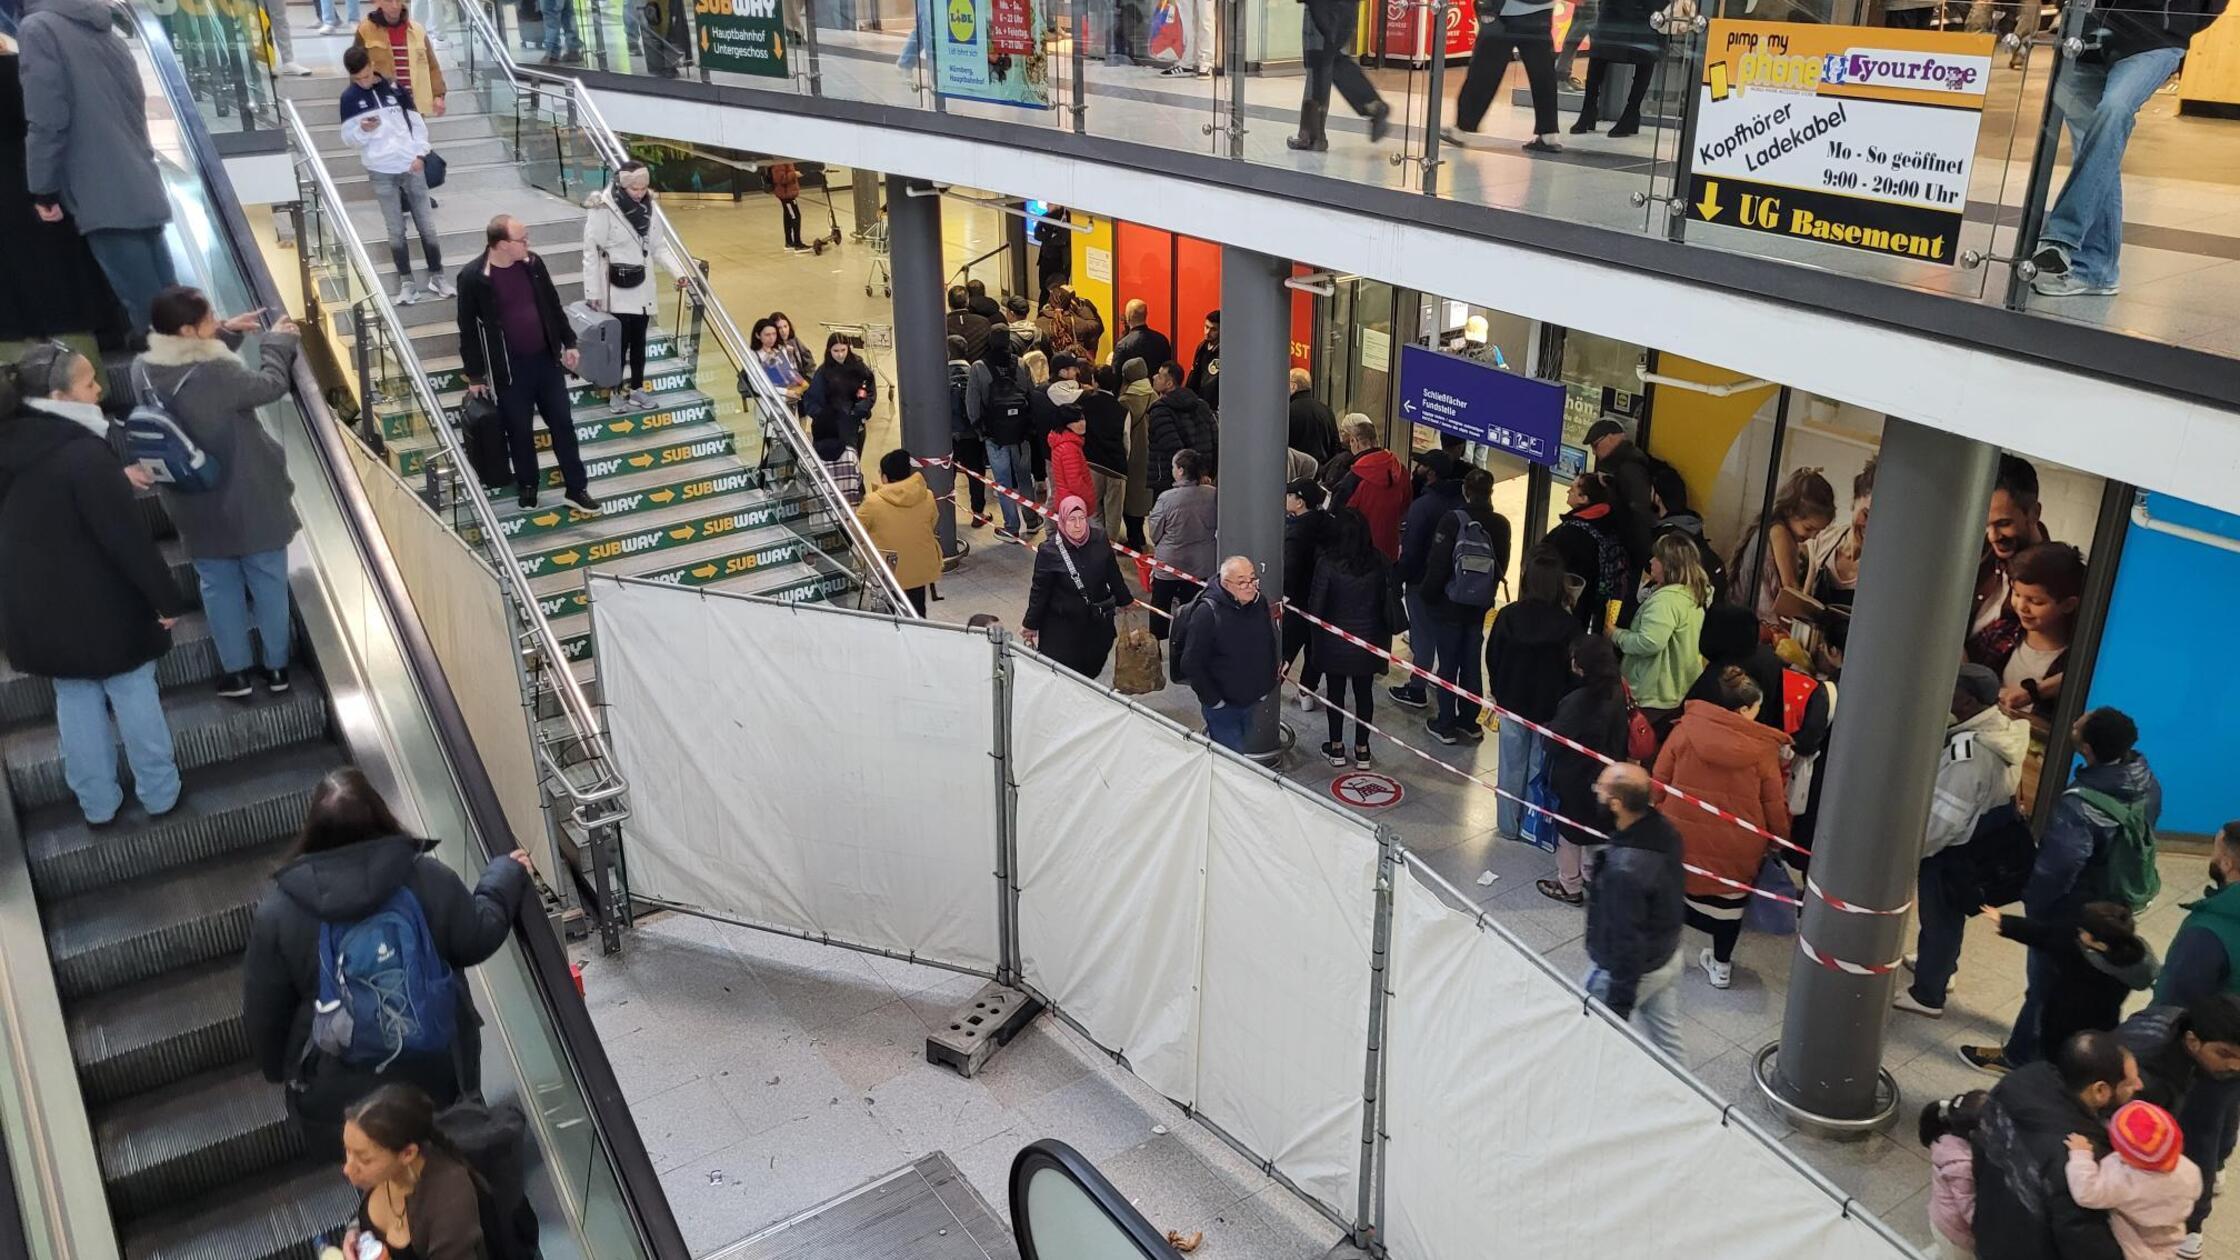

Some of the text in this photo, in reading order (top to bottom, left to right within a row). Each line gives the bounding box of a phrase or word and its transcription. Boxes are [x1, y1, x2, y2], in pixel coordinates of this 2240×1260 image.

[696, 0, 776, 18] SUBWAY
[711, 26, 766, 42] Hauptbahnhof
[1726, 31, 1789, 54] pimp my
[713, 42, 769, 59] Untergeschoss
[949, 75, 985, 86] Hauptbahnhof
[1738, 38, 1822, 97] phone
[1699, 102, 1793, 165] Kopfhörer
[1745, 102, 1848, 173] Ladekabel
[1826, 141, 1852, 161] Mo
[1866, 146, 1888, 166] So
[1891, 149, 1964, 176] geöffnet
[1822, 168, 1858, 190] 9:00
[1871, 175, 1920, 200] 20:00
[1925, 182, 1959, 205] Uhr
[1739, 193, 1945, 259] UG Basement
[1422, 388, 1468, 409] Schließfächer
[1422, 398, 1457, 417] Fundstelle
[641, 404, 707, 430] SUBWAY
[660, 439, 728, 464] SUBWAY
[682, 473, 749, 500] SUBWAY
[587, 531, 664, 561] SUBWAY
[702, 510, 770, 536] SUBWAY
[725, 547, 795, 574] SUBWAY
